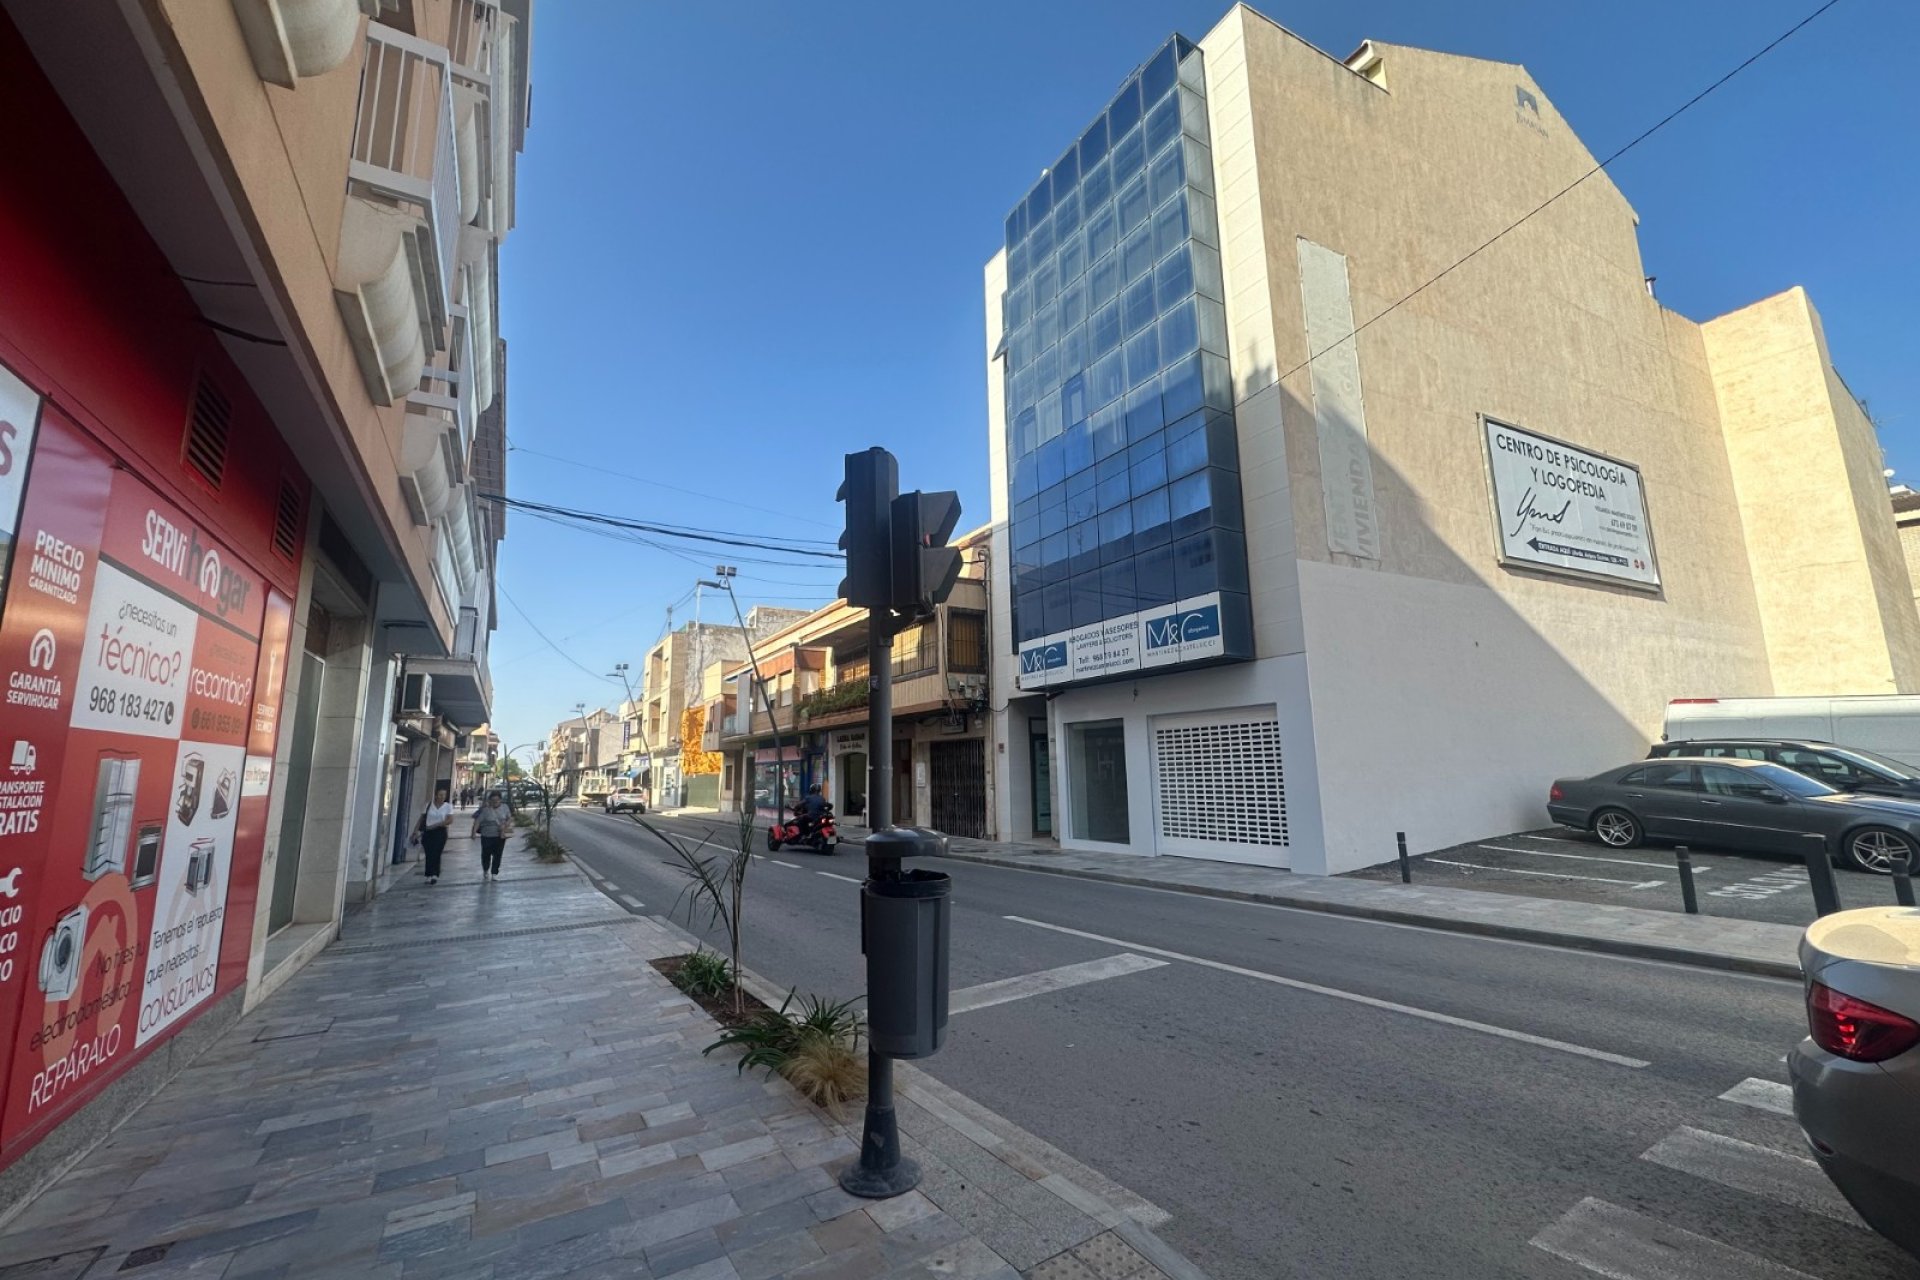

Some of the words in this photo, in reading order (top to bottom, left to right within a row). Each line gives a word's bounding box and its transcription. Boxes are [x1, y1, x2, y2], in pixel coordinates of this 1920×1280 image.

[1496, 434, 1543, 461] CENTRO
[1546, 448, 1561, 467] DE
[1564, 454, 1627, 486] PSICOLOGÍA
[1530, 466, 1538, 482] Y
[1542, 470, 1607, 501] LOGOPEDIA
[35, 529, 85, 571] PRECIO
[28, 576, 77, 605] GARANTIZADO
[118, 601, 166, 633] ¿necesitas
[166, 622, 177, 638] un
[1068, 627, 1100, 644] ABOGADOS
[1104, 621, 1139, 636] ASESORES
[98, 622, 181, 688] técnico?
[6, 690, 59, 710] SERVIHOGAR
[9, 670, 62, 696] GARANTÍA
[189, 666, 252, 707] recambio?
[89, 685, 117, 714] 968
[119, 692, 142, 718] 183
[143, 697, 165, 722] 427
[153, 920, 187, 951] Tenemos
[186, 915, 195, 934] el
[146, 961, 165, 988] que
[28, 1023, 121, 1114] REPÁRALO
